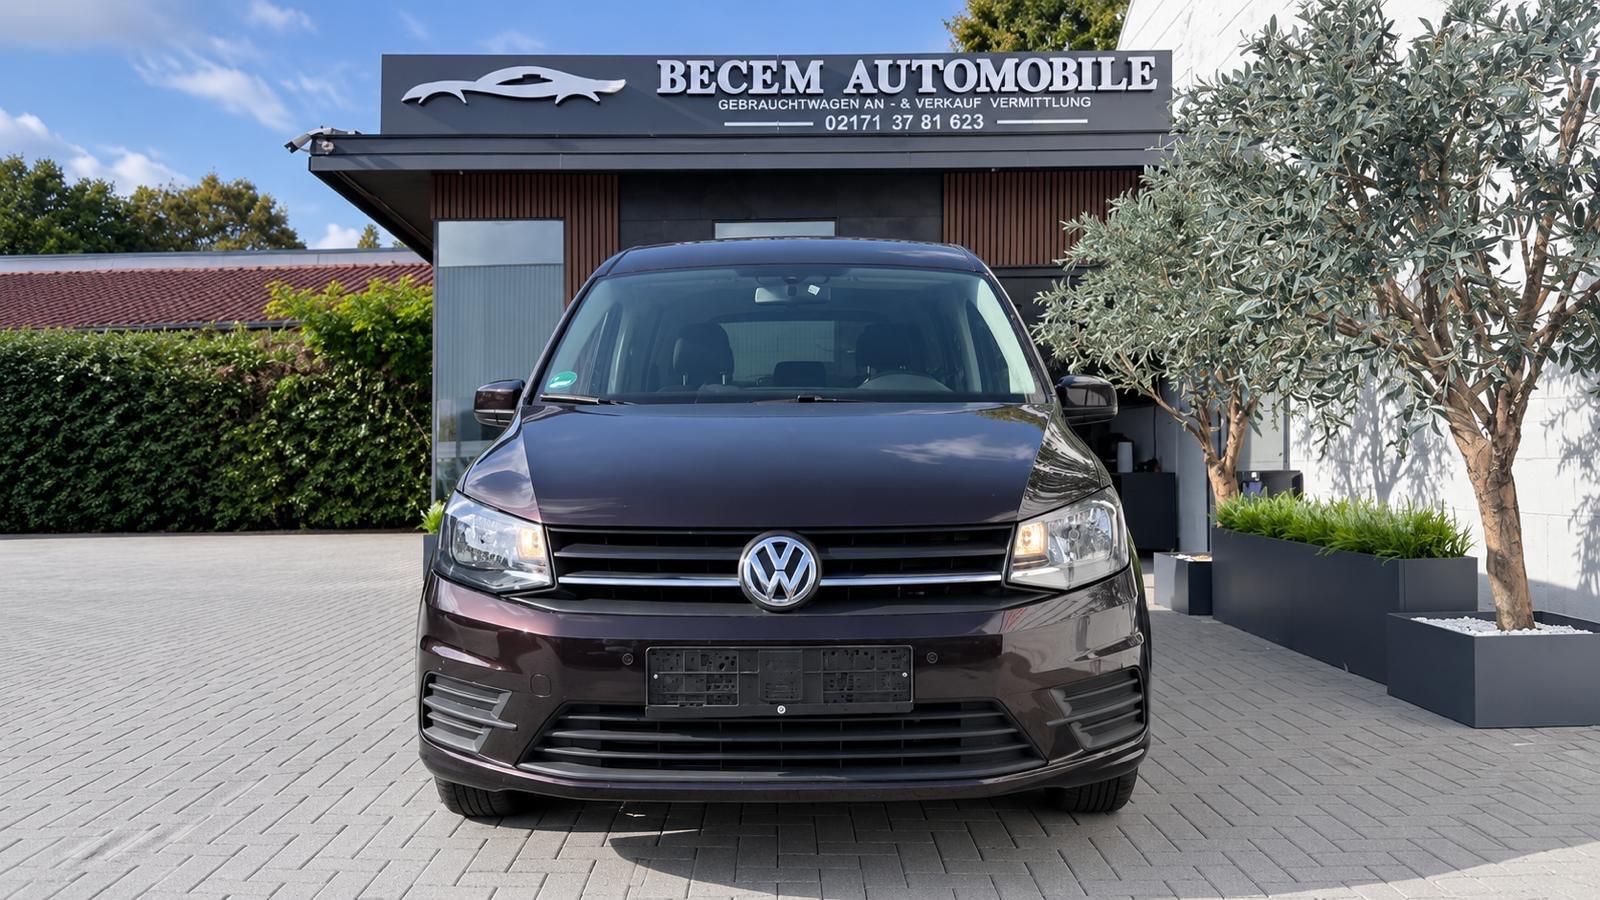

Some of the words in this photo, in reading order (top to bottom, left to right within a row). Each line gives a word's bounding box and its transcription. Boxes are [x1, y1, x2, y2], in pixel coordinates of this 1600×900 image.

[656, 59, 824, 94] BECEM
[843, 56, 1158, 94] AUTOMOBILE
[718, 98, 860, 111] GEBRAUCHTWAGEN
[864, 98, 884, 110] AN
[900, 98, 911, 109] &
[915, 97, 982, 109] VERKAUF
[990, 96, 1092, 108] VERMITTLUNG
[825, 114, 880, 131] 02171
[892, 114, 913, 130] 37
[921, 114, 941, 130] 81
[950, 113, 984, 130] 623
